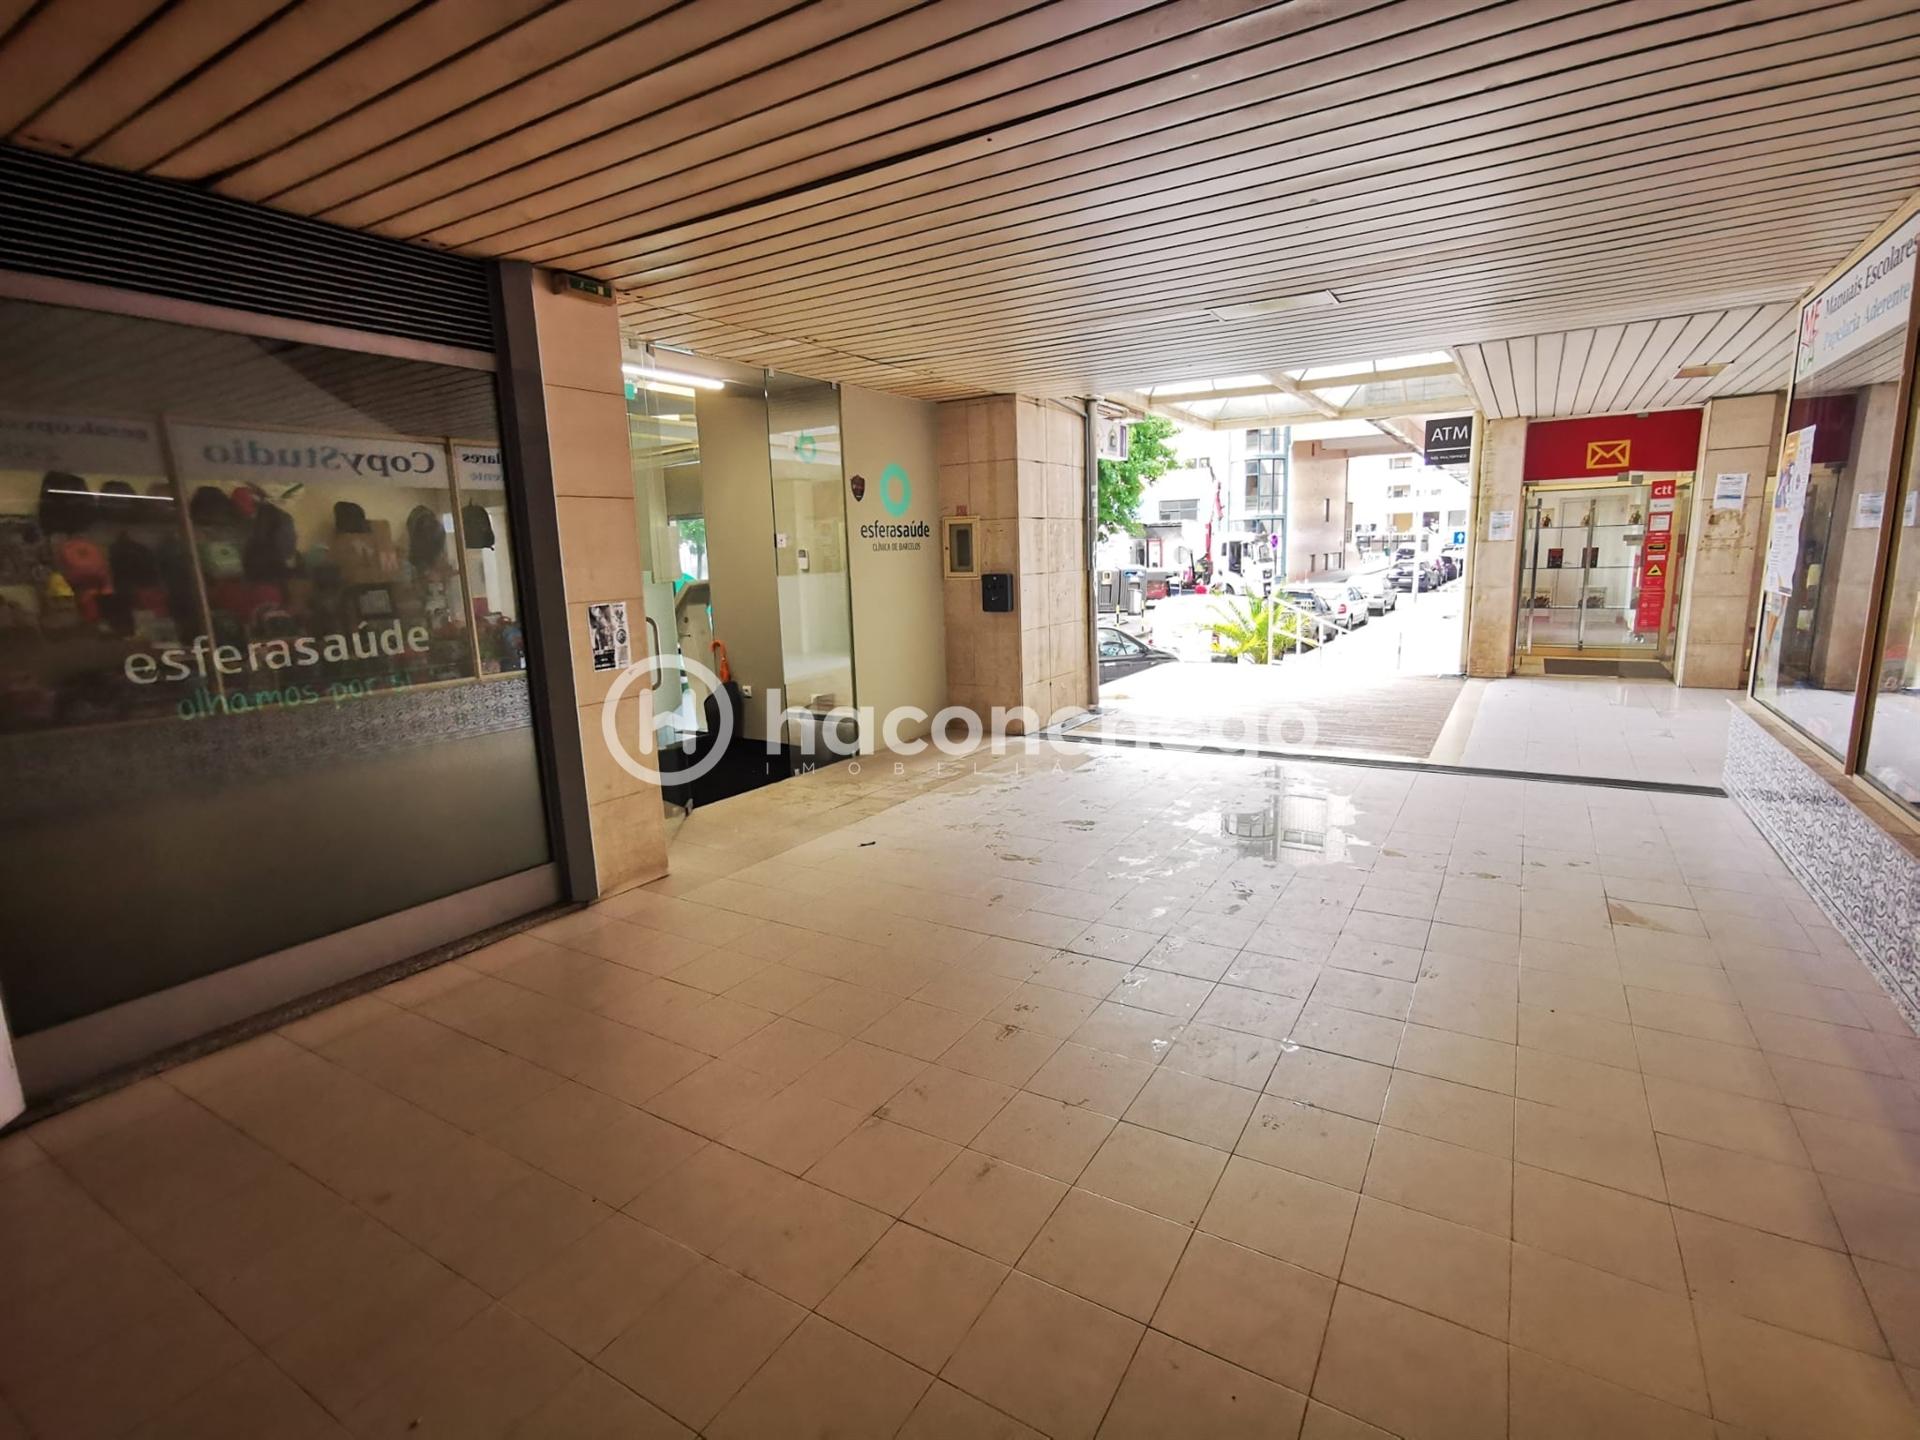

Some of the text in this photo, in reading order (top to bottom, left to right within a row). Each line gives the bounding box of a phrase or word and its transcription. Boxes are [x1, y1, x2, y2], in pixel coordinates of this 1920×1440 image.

[1431, 425, 1468, 442] ATM
[1654, 485, 1673, 496] ctt
[860, 520, 930, 538] esferasaúde
[123, 619, 430, 685] esferasaúde
[176, 685, 319, 721] olhamos
